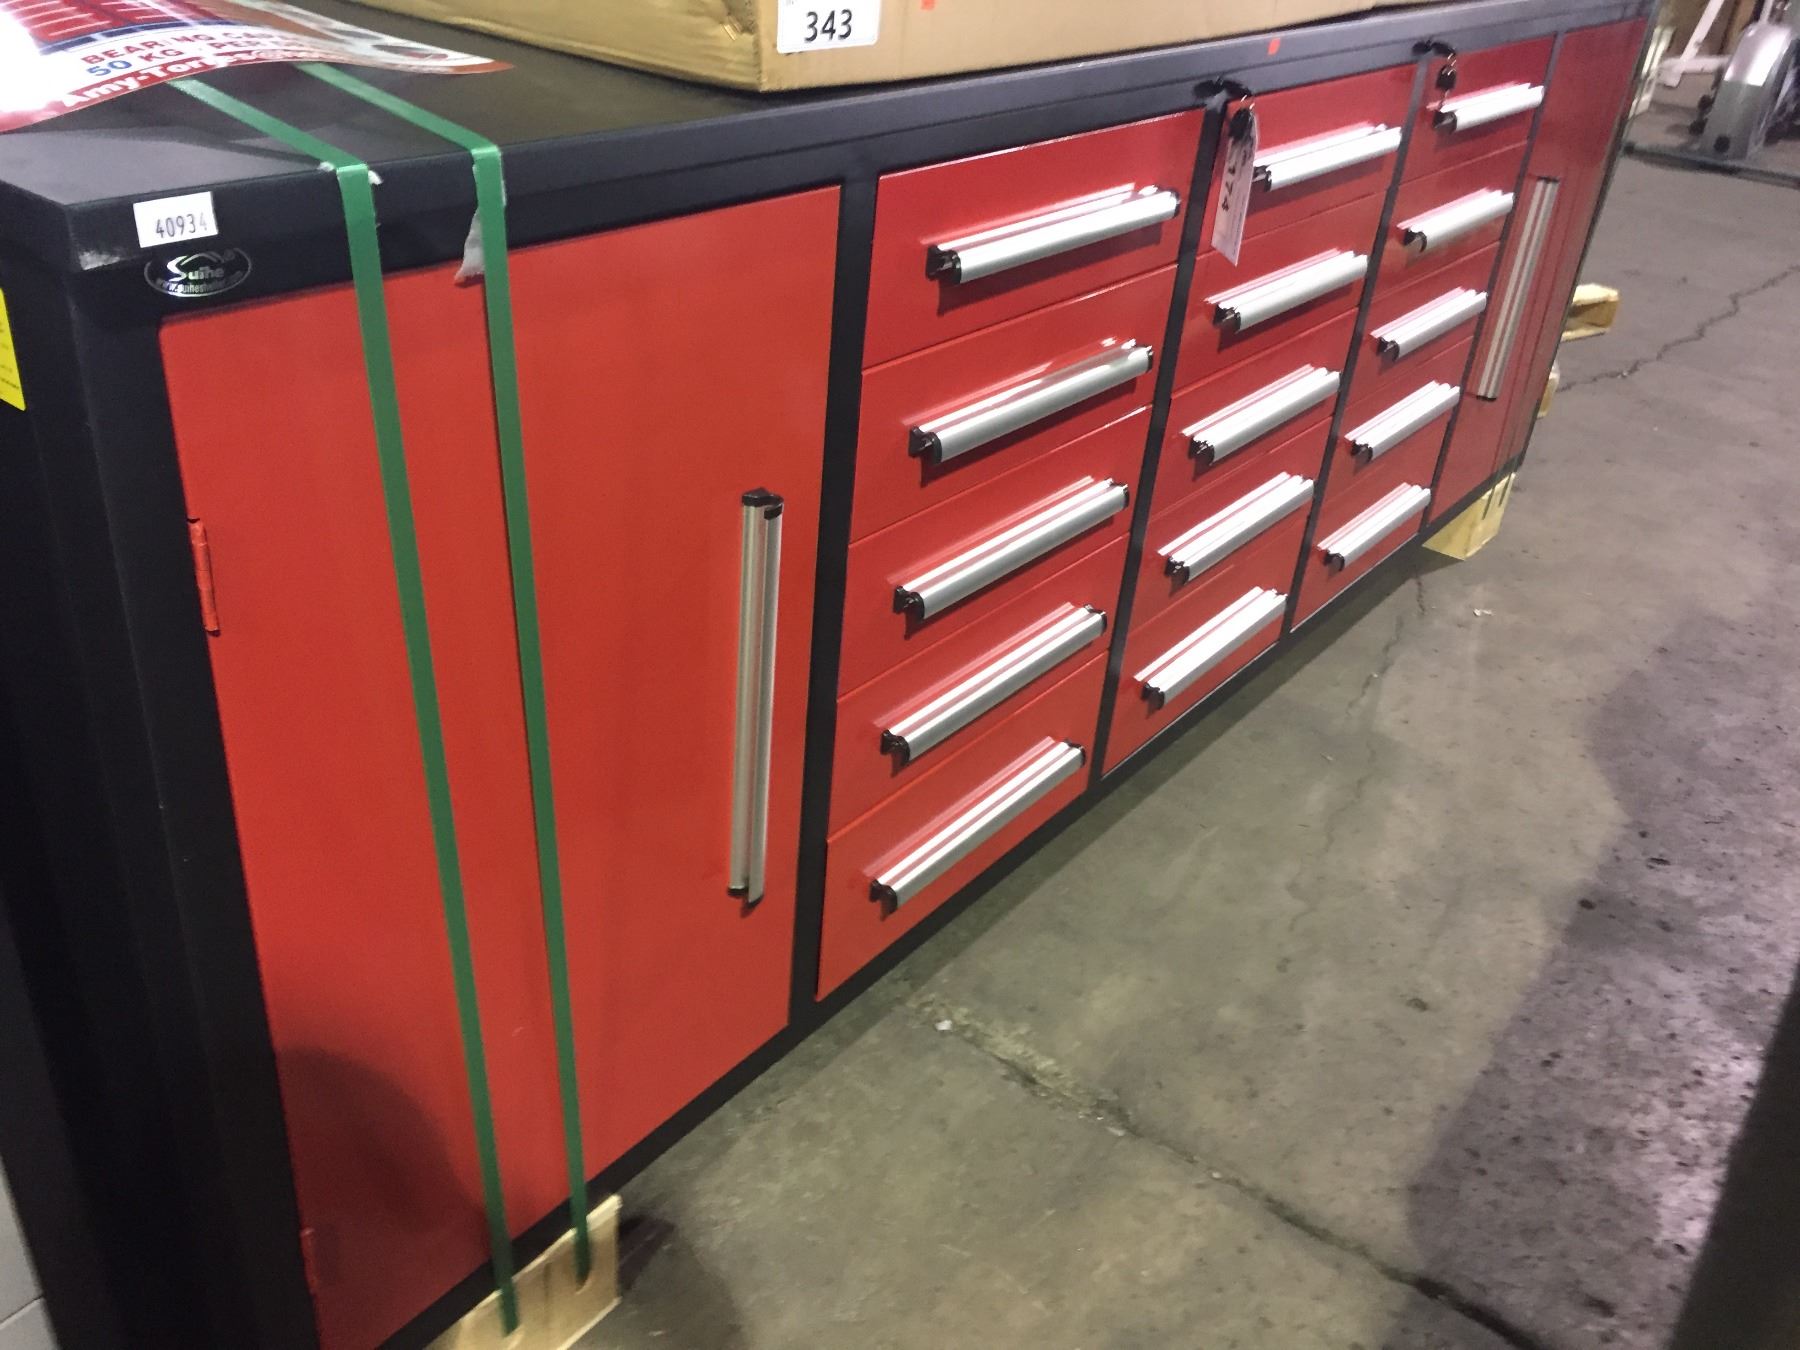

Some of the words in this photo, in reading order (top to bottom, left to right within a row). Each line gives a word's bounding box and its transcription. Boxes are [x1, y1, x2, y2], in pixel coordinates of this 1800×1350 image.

[804, 9, 853, 43] 343
[86, 59, 132, 77] 50
[138, 48, 184, 62] KG
[155, 212, 208, 239] 40934
